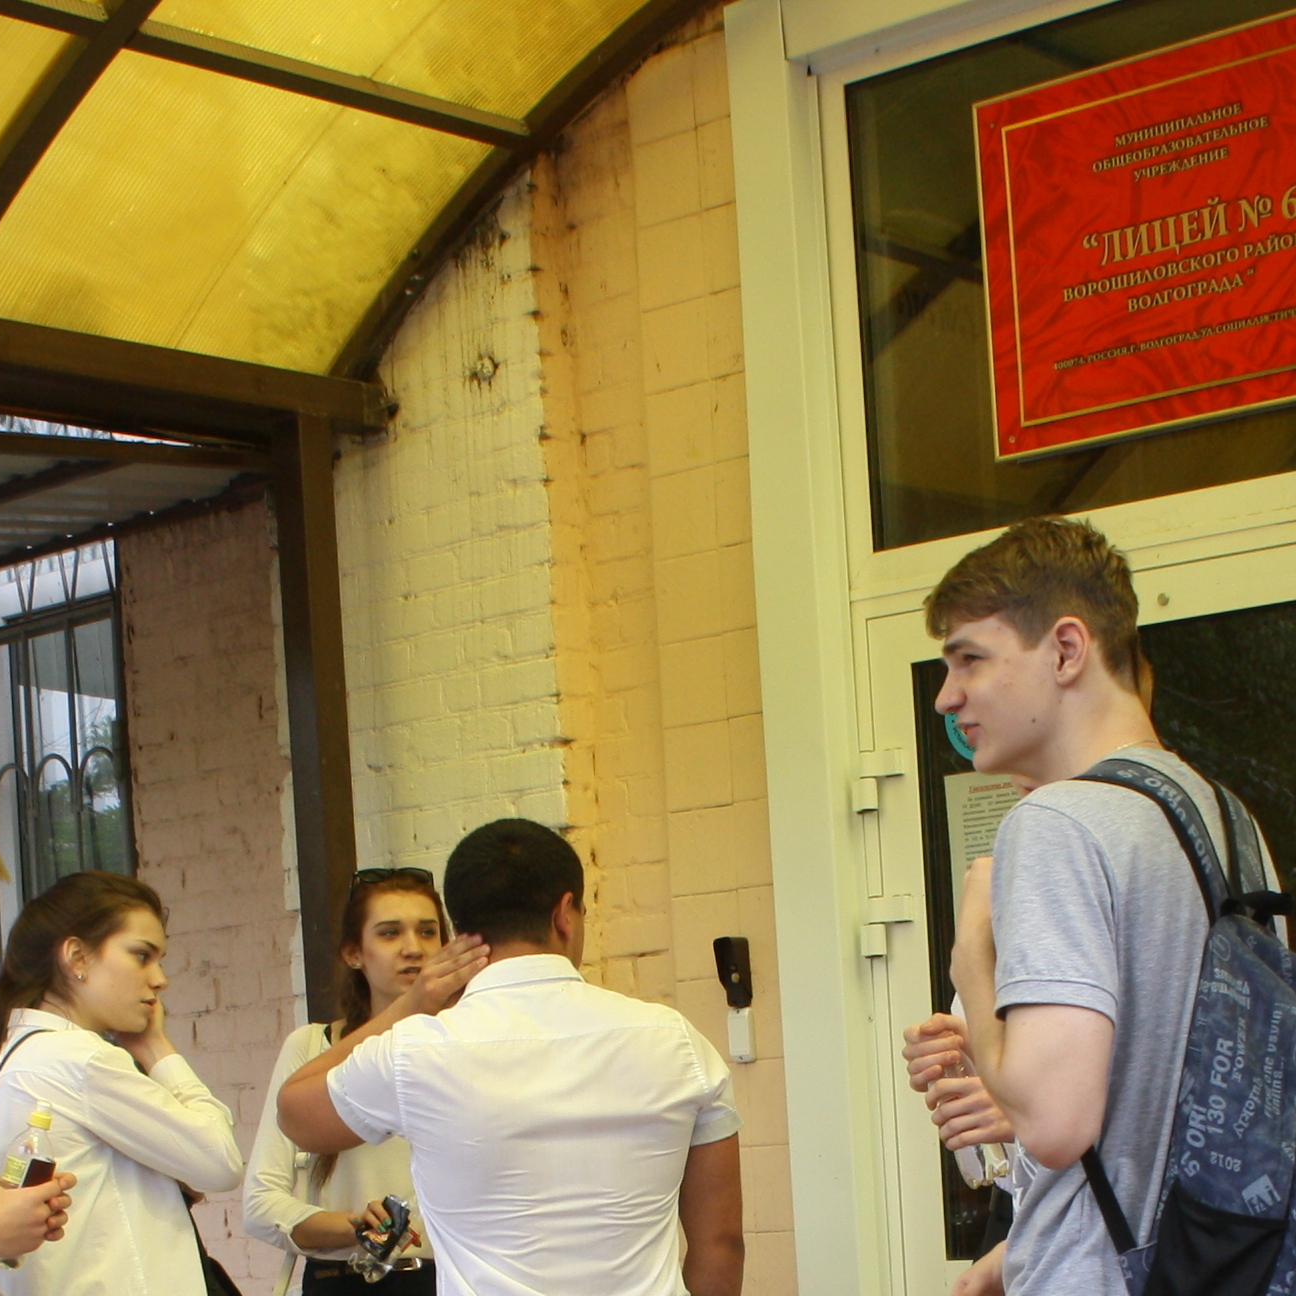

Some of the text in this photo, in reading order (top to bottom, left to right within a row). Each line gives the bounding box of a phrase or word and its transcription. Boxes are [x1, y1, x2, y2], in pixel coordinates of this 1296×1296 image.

[1092, 116, 1269, 172] ОБЩЕОБРАЗОВАТЕЛЬНОЕ
[1115, 102, 1242, 147] МУНИЦИПАЛЬНОЕ
[1134, 147, 1229, 182] УЧРЕЖДЕНИЕ
[1062, 248, 1240, 302] ВОРОШИЛОВСКОГО
[1128, 273, 1244, 313] ВОЛГОГРАДА
[1209, 1037, 1235, 1089] FOR
[1205, 1094, 1226, 1135] 130
[1209, 1151, 1242, 1173] 2012
